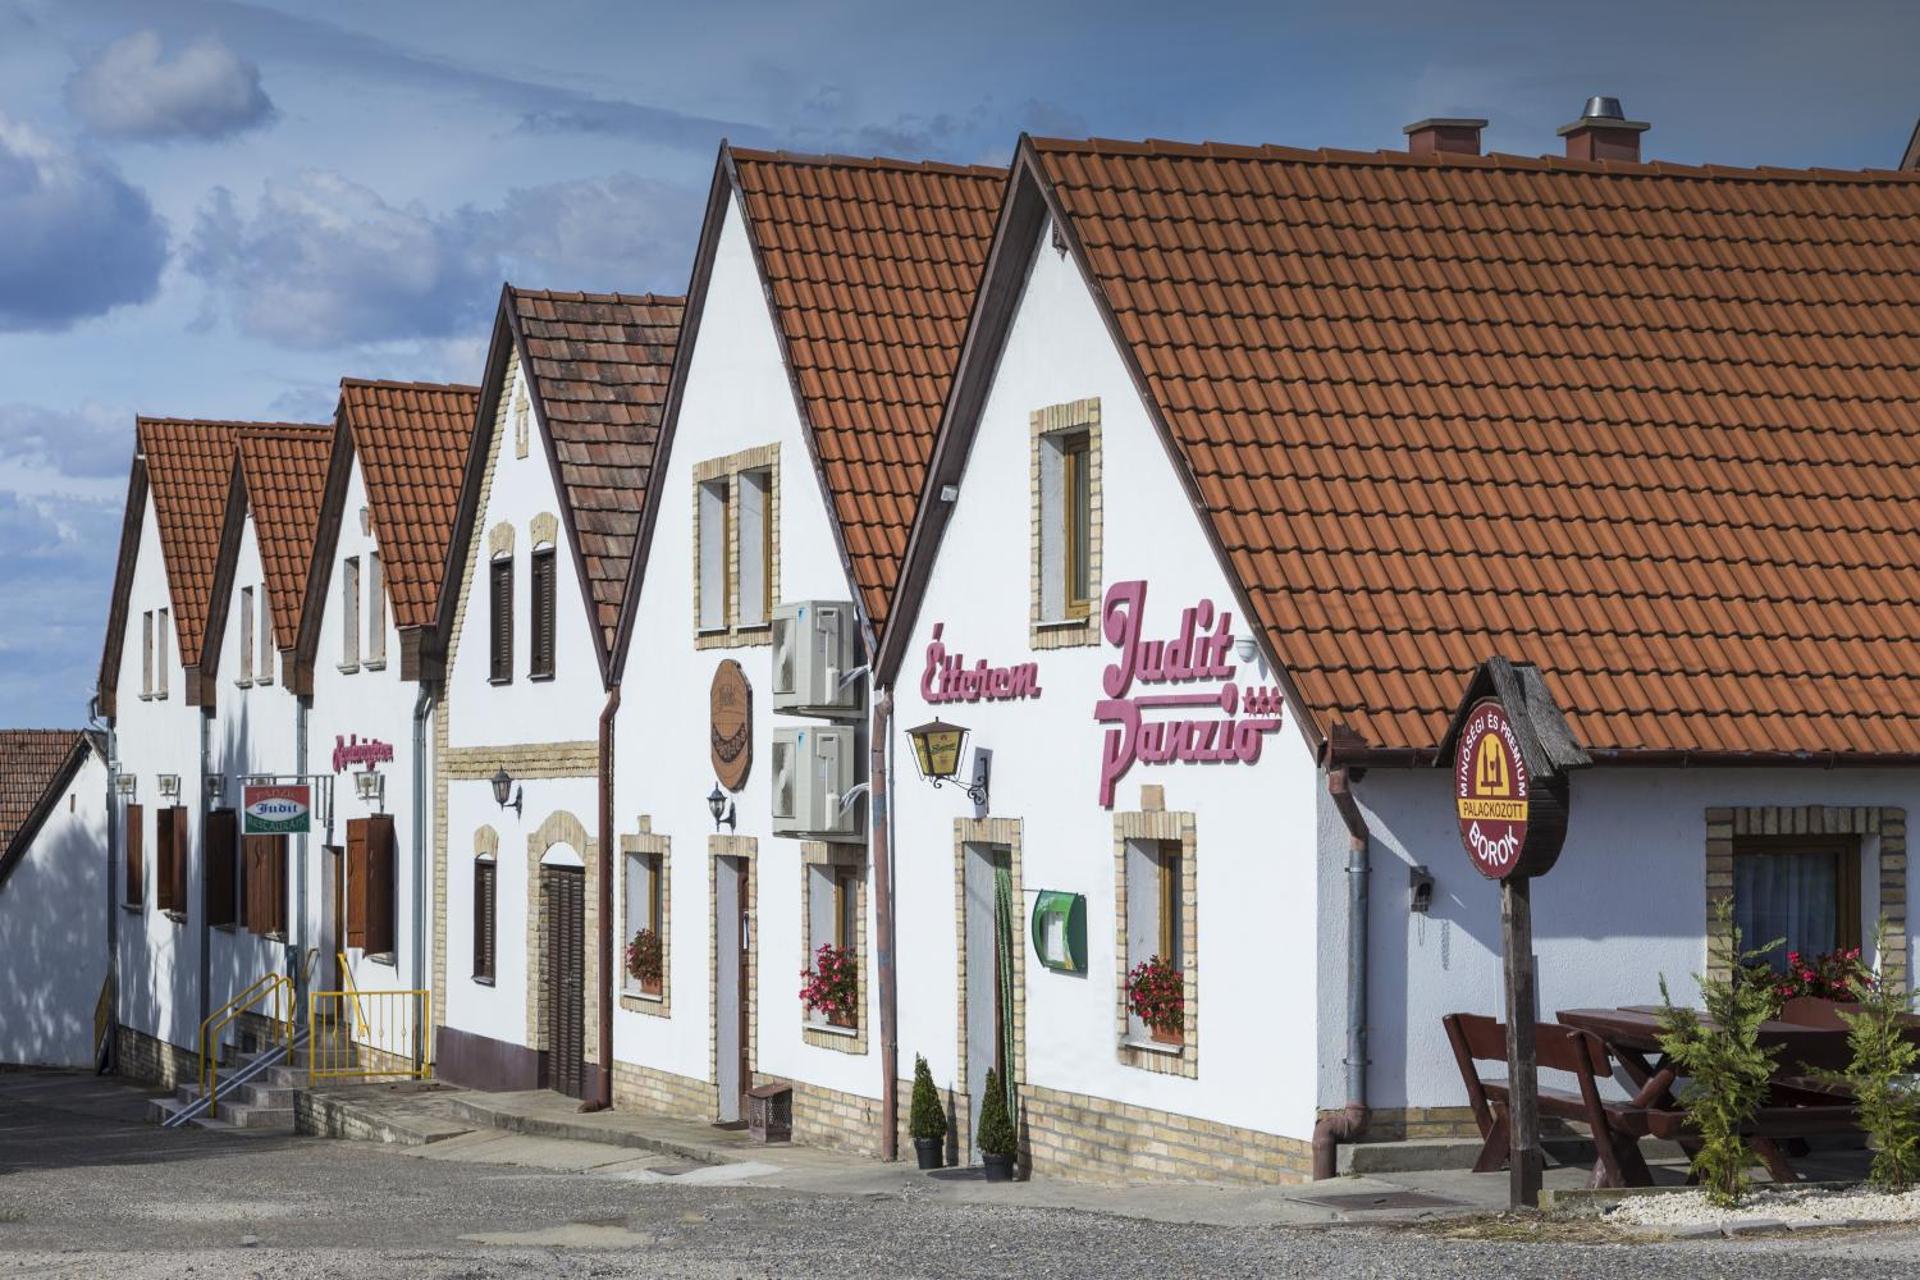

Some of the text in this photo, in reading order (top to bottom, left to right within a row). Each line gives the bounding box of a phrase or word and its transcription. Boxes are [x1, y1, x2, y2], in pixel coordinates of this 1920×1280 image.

[1103, 580, 1237, 699] Judit
[921, 622, 1042, 704] Étterem
[1487, 710, 1499, 731] ÉS
[255, 802, 299, 815] Judit
[1463, 802, 1524, 818] PALACKOZOTT
[1469, 821, 1519, 867] BOROK
